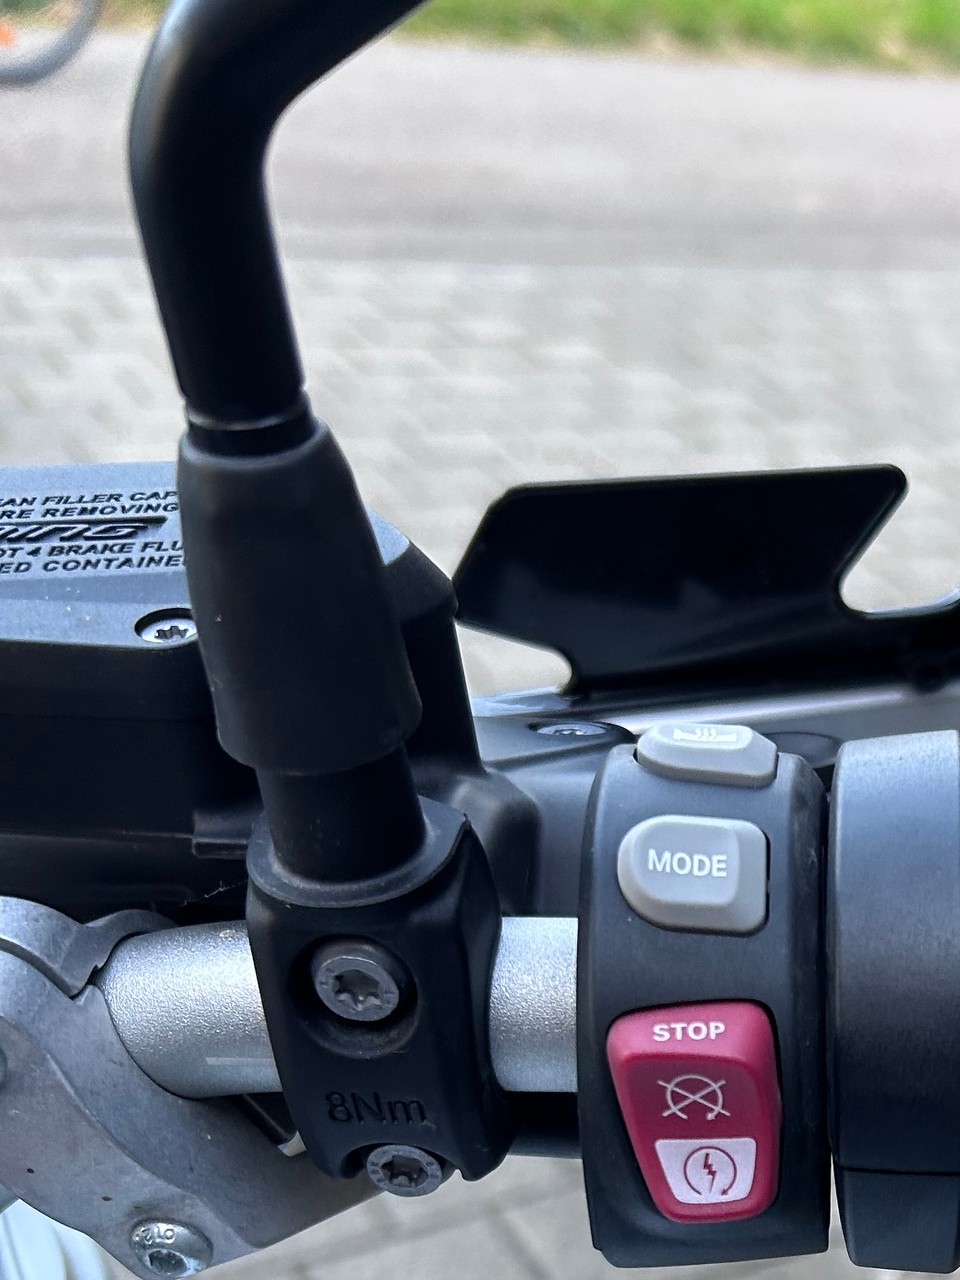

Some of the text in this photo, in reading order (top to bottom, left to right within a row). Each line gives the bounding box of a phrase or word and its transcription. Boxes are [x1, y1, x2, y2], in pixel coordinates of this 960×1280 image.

[0, 491, 178, 507] AN FILLER CAP
[41, 503, 180, 518] REMOVING
[27, 546, 42, 557] 4
[47, 542, 135, 557] BRAKE
[42, 554, 186, 572] CONTAINE
[648, 848, 727, 877] MODE
[653, 1021, 726, 1042] STOP
[325, 1091, 429, 1124] 8Nm
